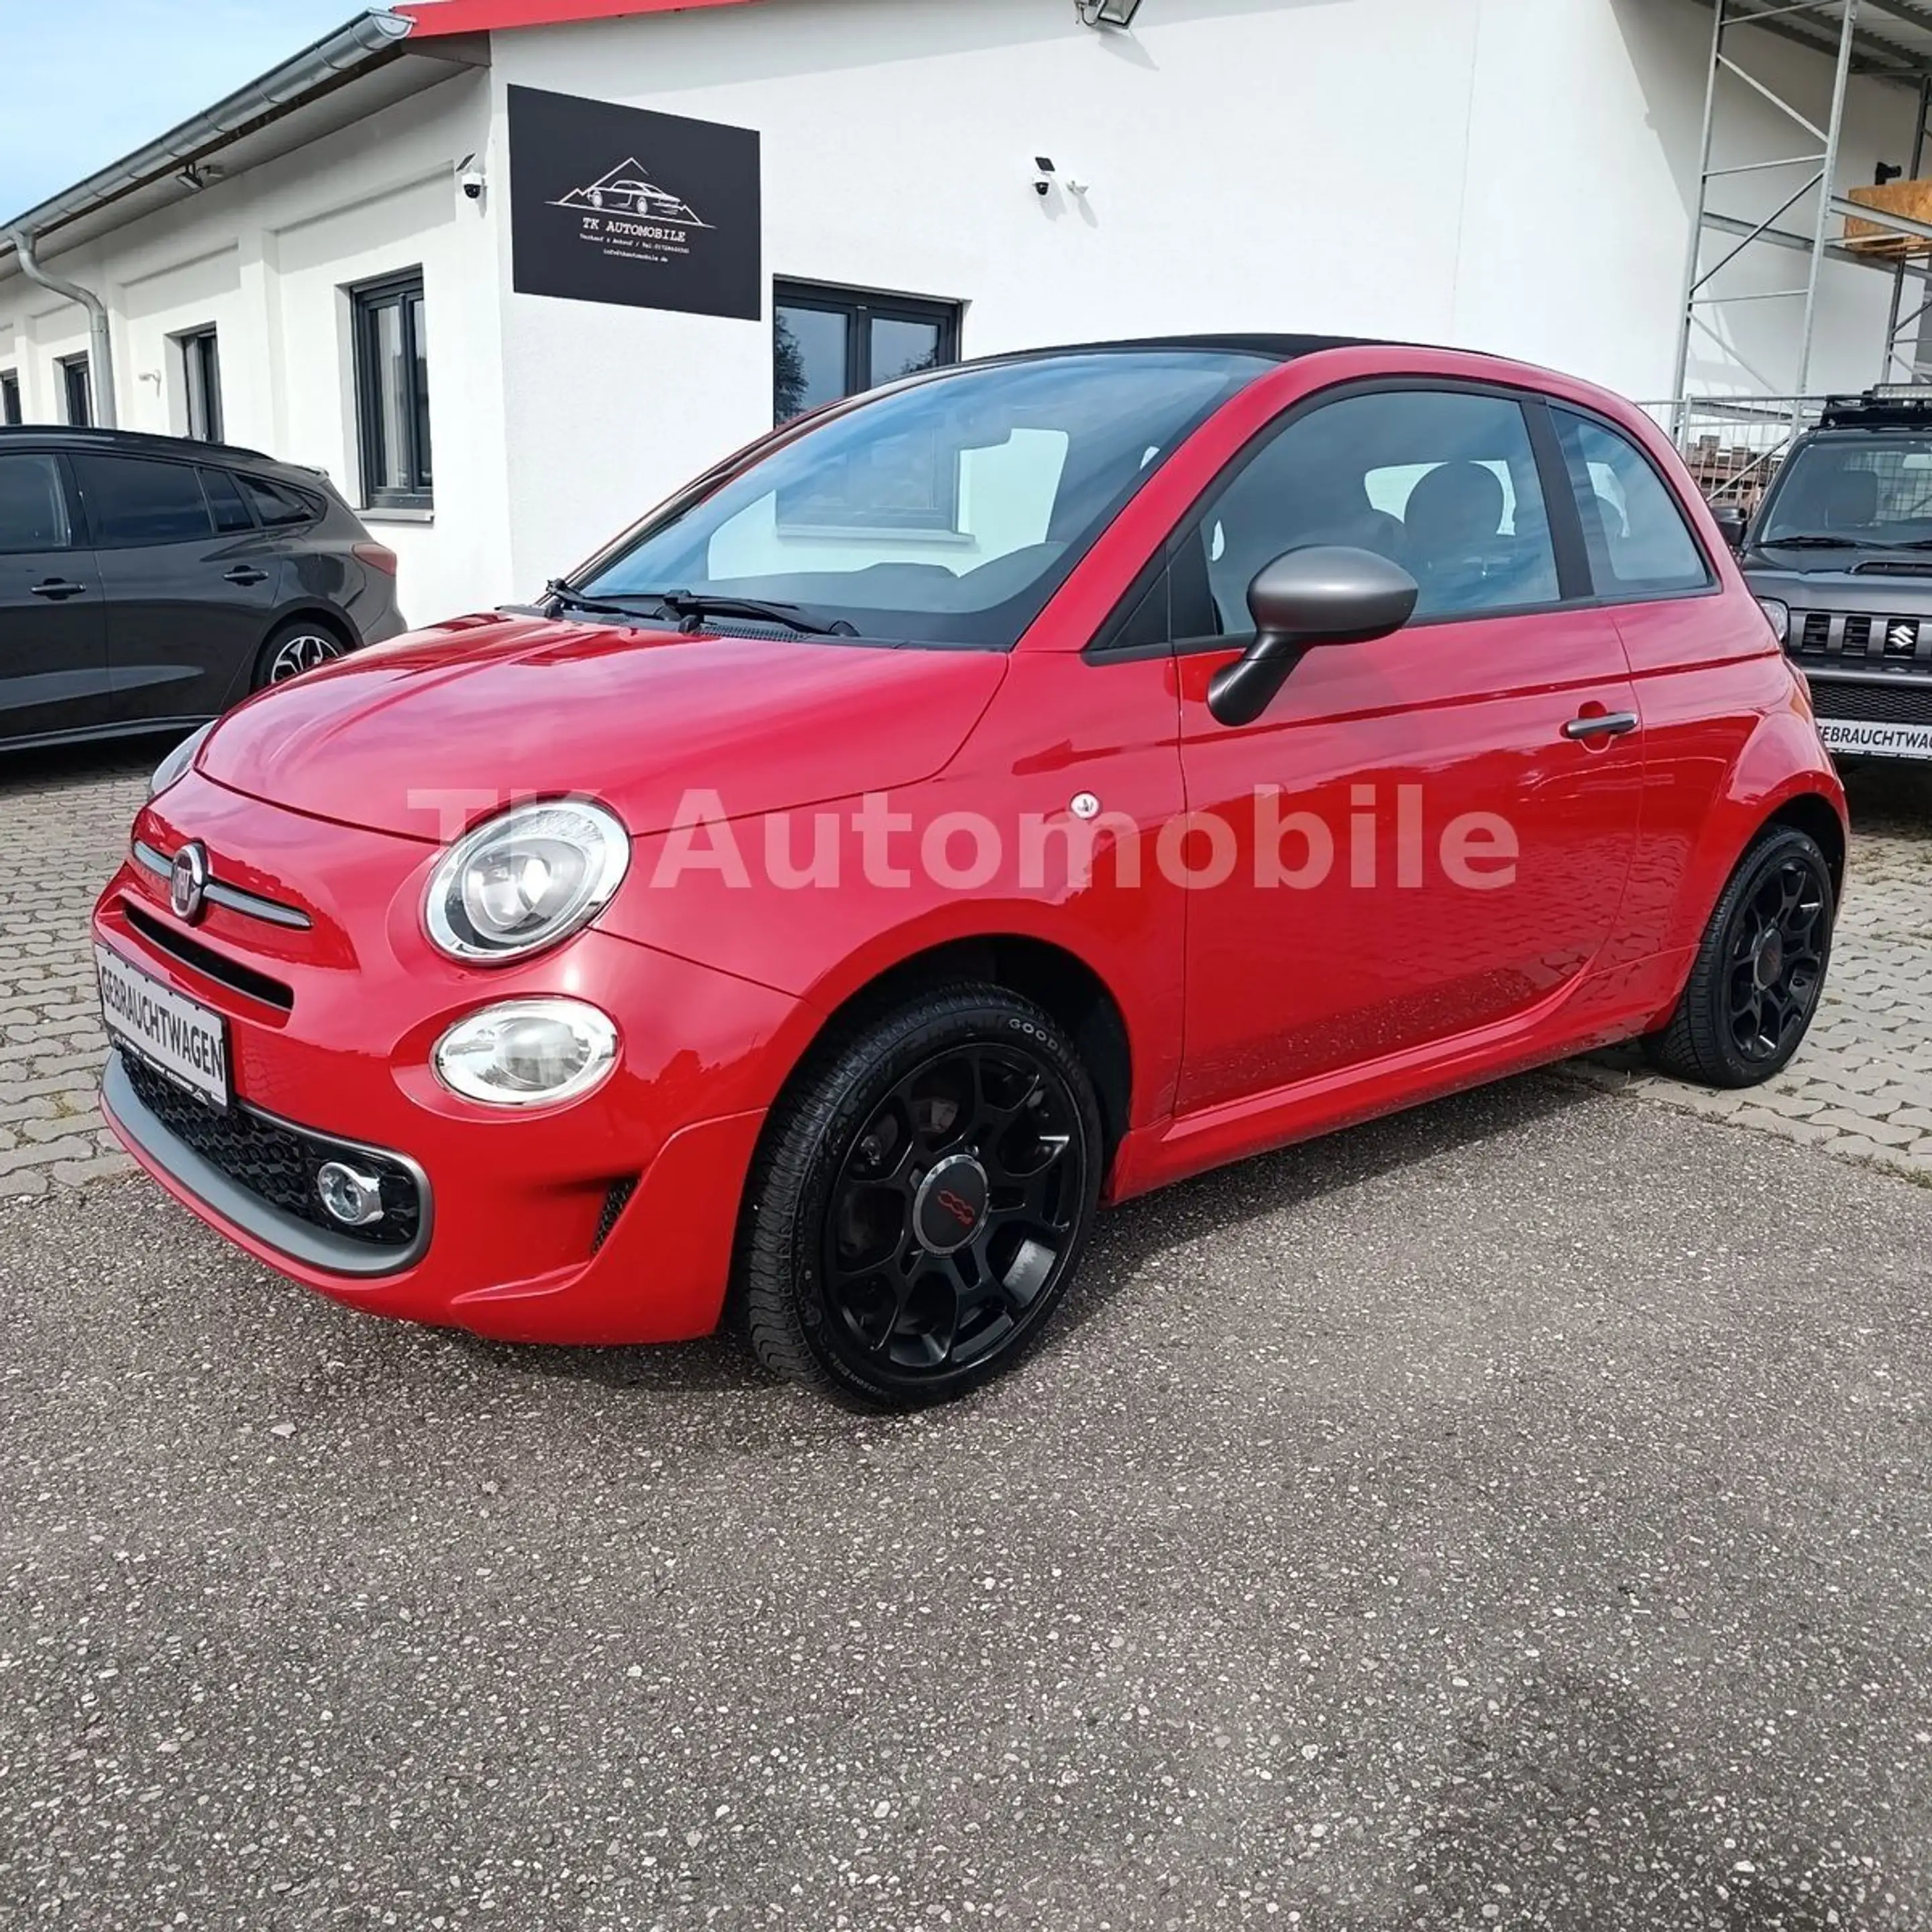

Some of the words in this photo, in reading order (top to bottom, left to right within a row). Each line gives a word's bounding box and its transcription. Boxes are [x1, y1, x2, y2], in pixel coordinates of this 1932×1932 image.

[583, 217, 600, 229] TK
[605, 221, 686, 242] AUTOMOBILE
[1818, 725, 1932, 749] EBRAUCHTWA
[101, 965, 223, 1083] GEBRAUCHTWAGEN
